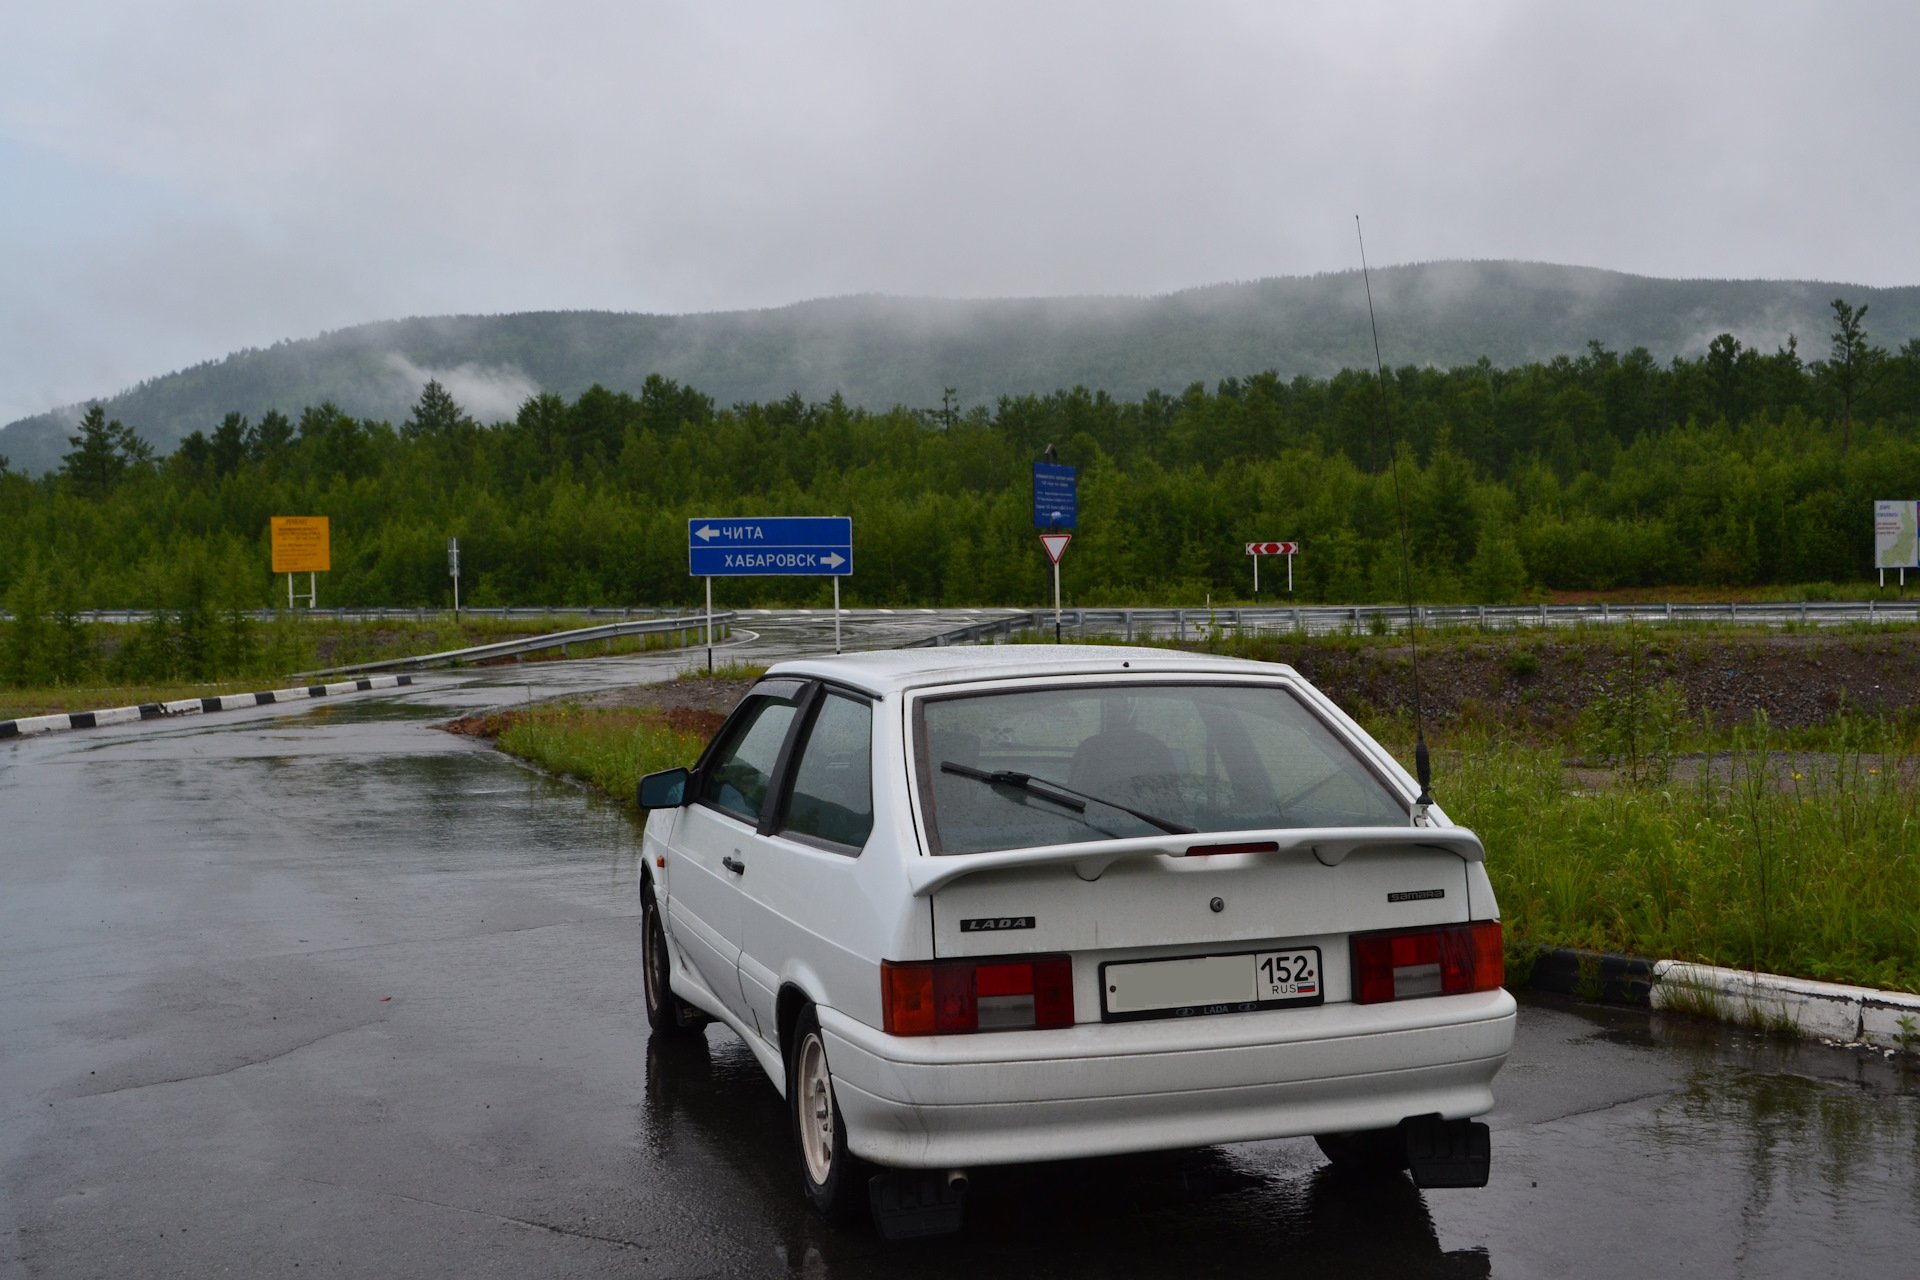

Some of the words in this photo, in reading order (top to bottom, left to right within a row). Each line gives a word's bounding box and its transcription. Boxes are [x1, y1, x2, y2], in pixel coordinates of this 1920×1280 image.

[722, 526, 764, 540] ЧИТА
[724, 553, 817, 567] ХАБАРОВСК
[969, 918, 1027, 930] LADA
[1260, 955, 1309, 984] 152
[1272, 983, 1297, 995] RUS
[1203, 1004, 1229, 1015] LADA
